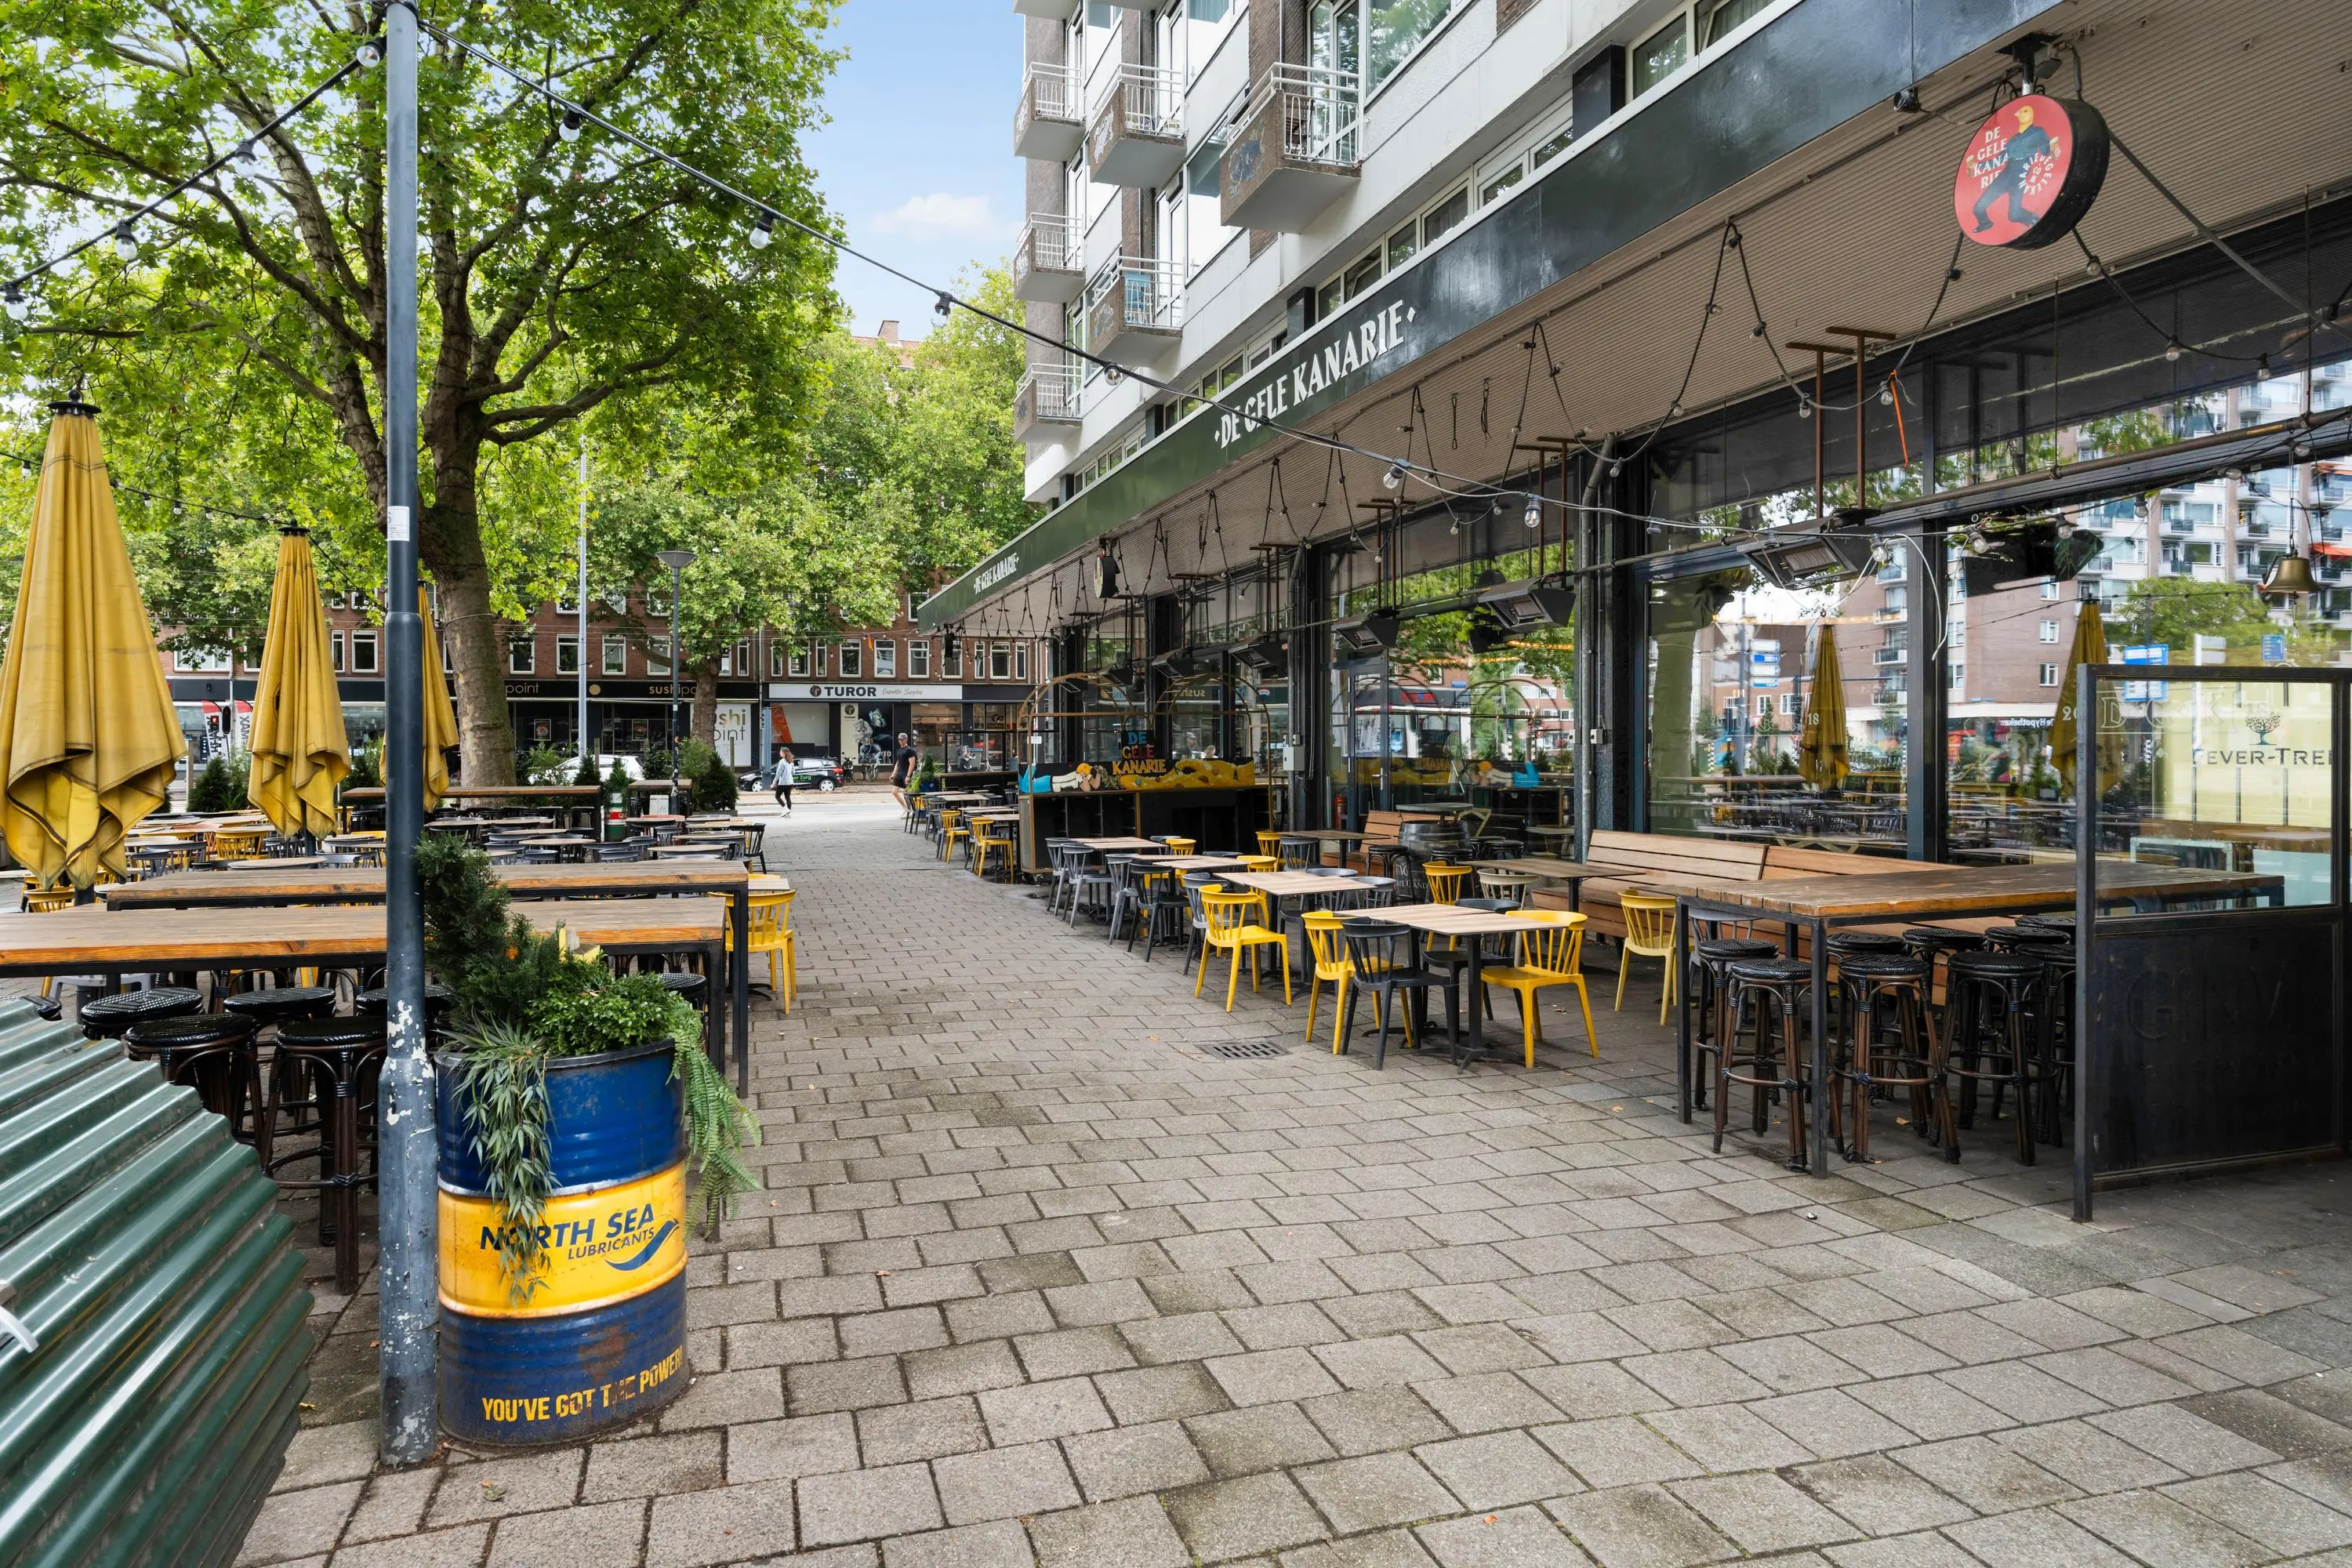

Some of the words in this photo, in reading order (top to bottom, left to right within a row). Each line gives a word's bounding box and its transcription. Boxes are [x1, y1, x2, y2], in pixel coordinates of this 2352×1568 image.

[1985, 126, 2001, 143] DE
[1977, 138, 2007, 161] GELE
[1221, 405, 1240, 448] DE
[1244, 374, 1288, 433] GELE
[1293, 299, 1404, 406] KANARIE
[975, 575, 982, 594] DE
[993, 552, 1017, 584] KANARIE
[505, 683, 539, 697] point
[824, 686, 877, 697] TUROR
[715, 709, 746, 725] shi
[1807, 713, 1820, 725] 18
[714, 726, 746, 741] oint
[1127, 731, 1147, 744] DE
[1112, 759, 1167, 775] KANARIE
[605, 1203, 655, 1238] SEA
[568, 1226, 655, 1260] LUBRICANTS
[481, 1397, 550, 1421] YOU'VE
[556, 1388, 596, 1417] GOT
